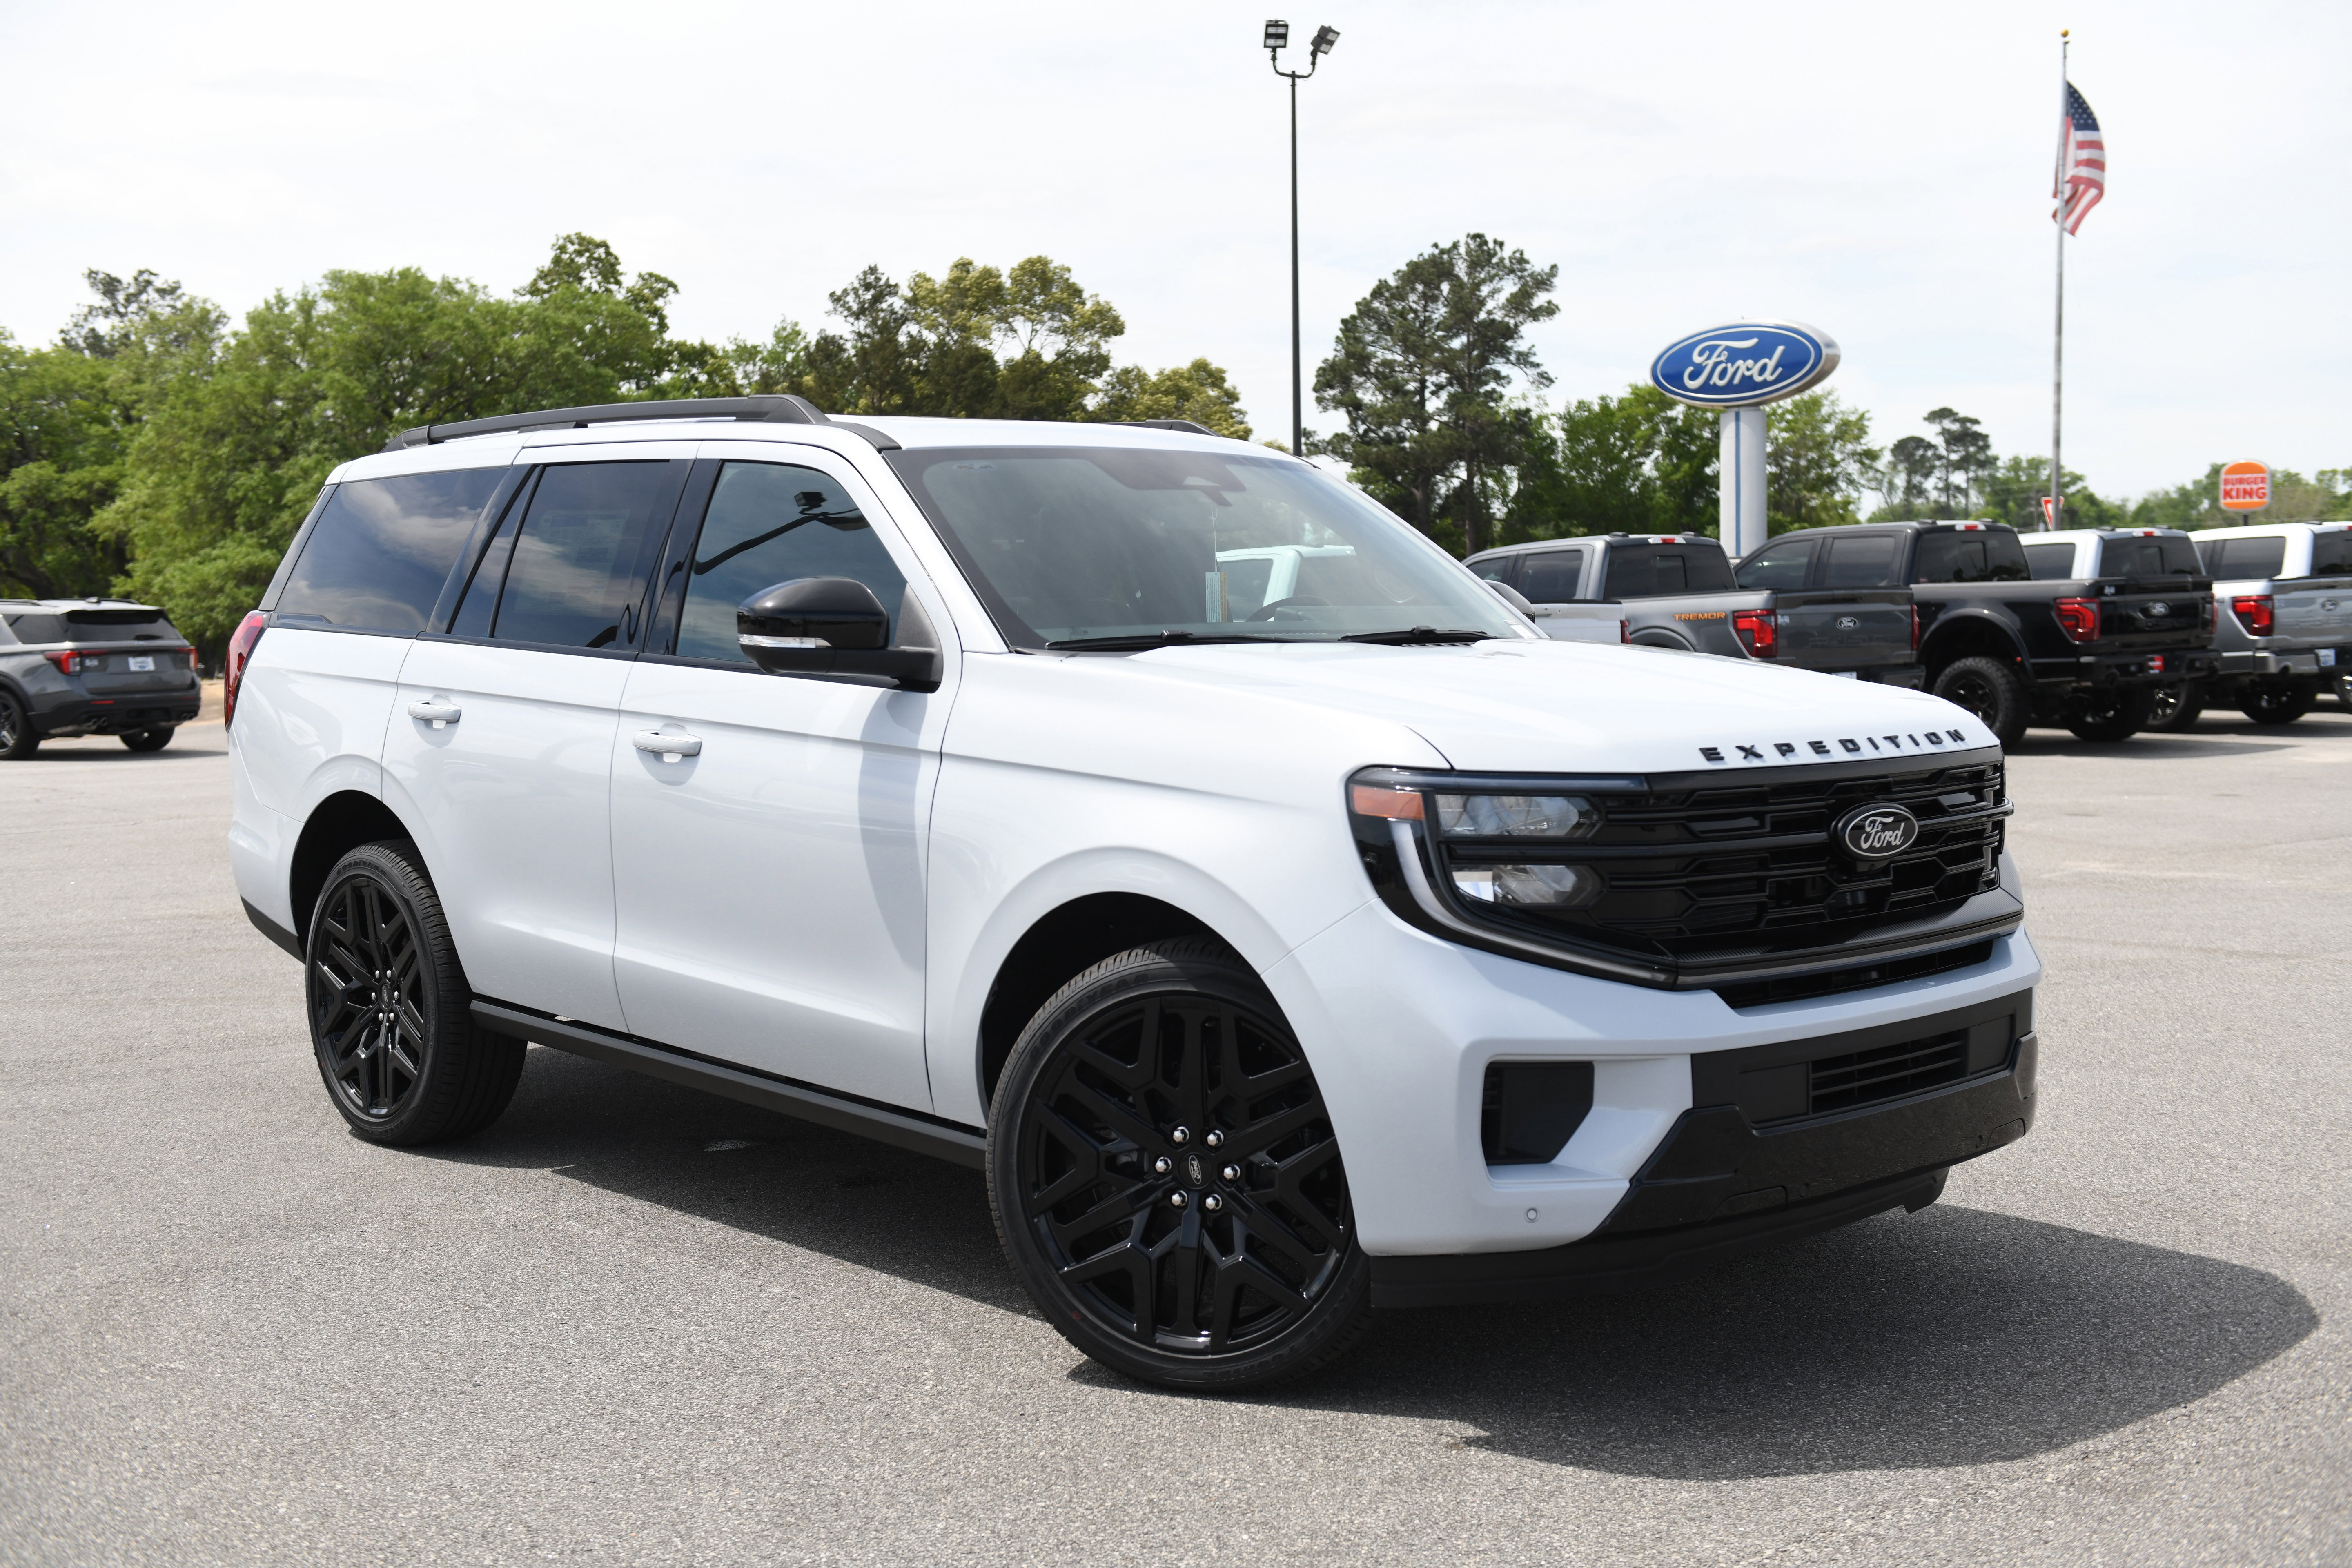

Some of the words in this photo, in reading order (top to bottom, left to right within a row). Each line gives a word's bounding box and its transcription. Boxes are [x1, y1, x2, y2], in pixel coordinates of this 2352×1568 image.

[1683, 337, 1786, 390] Ford
[2223, 476, 2267, 486] BURGER
[2223, 486, 2267, 499] KING
[1674, 611, 1726, 621] TREMOR
[1698, 728, 1967, 761] EXPEDITION
[1860, 816, 1904, 849] Ford
[336, 859, 387, 876] GOODYEAR
[1029, 973, 1149, 1060] GOODYEAR
[1190, 1160, 1201, 1180] Ford
